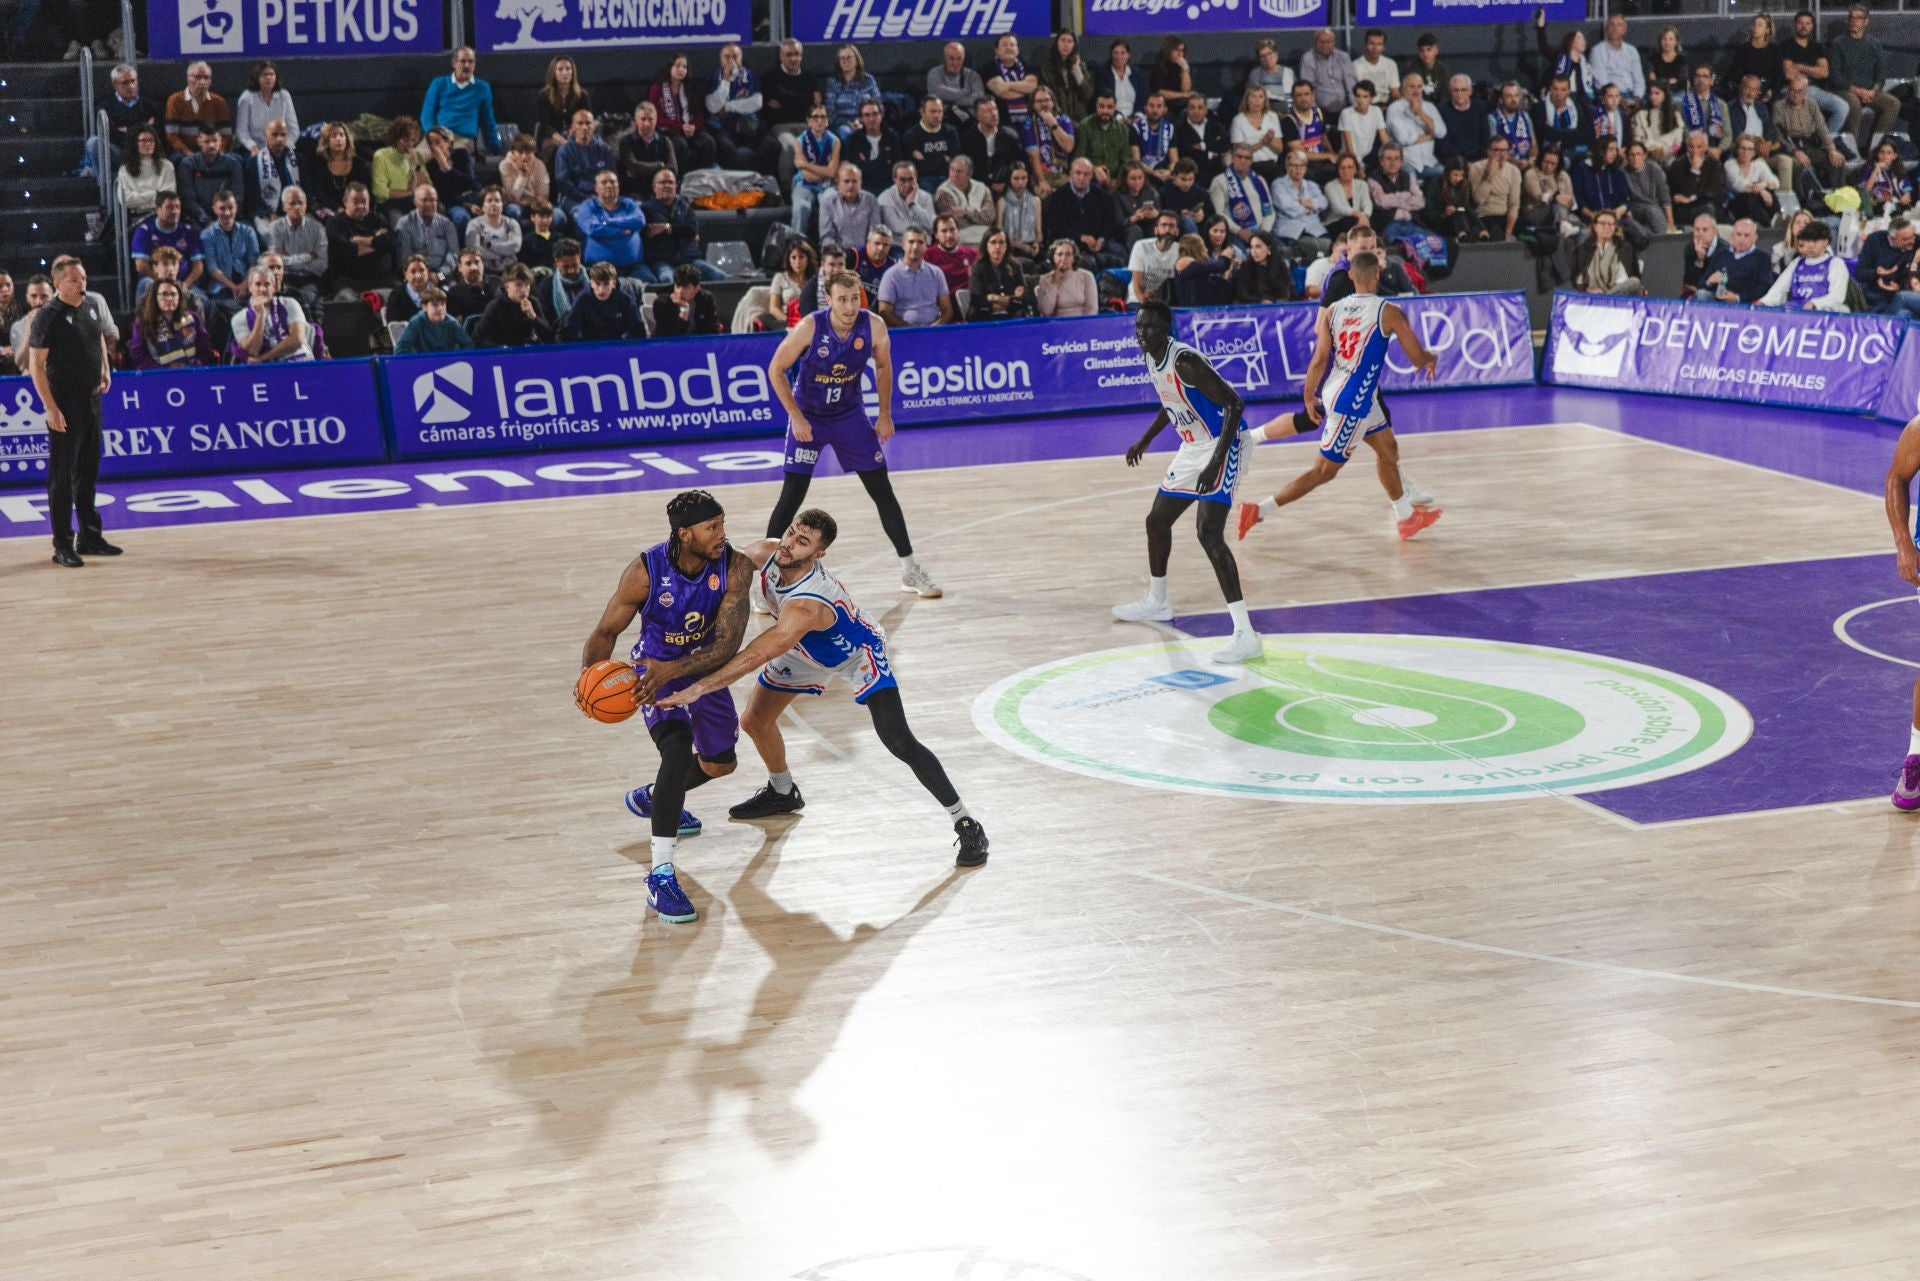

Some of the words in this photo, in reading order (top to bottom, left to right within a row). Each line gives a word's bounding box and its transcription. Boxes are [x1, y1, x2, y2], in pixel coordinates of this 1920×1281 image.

[259, 0, 419, 45] PETKUS
[579, 0, 727, 29] TECNICAMPO
[1042, 341, 1088, 355] Servicios
[1090, 336, 1139, 352] Energétic
[1202, 336, 1257, 355] LuRoPal
[1640, 316, 1886, 365] DENTOMEDIC
[1084, 354, 1146, 370] Climatizació
[493, 352, 771, 419] lambda
[898, 355, 1031, 398] épsilon
[1098, 373, 1151, 388] Calefacció
[1679, 363, 1746, 384] CLÍNICAS
[1749, 369, 1826, 391] DENTALES
[826, 387, 842, 404] 13
[903, 397, 946, 409] SOLUCIONES
[947, 394, 981, 406] TÉRMICAS
[982, 394, 988, 403] Y
[988, 391, 1034, 402] ENERGÉTICAS
[102, 426, 175, 458] REY
[190, 416, 346, 452] SANCHO
[419, 425, 496, 443] cámaras
[501, 417, 600, 441] frigoríficas
[617, 407, 773, 431] www.proylam.es
[16, 442, 49, 455] SANC
[1584, 680, 1675, 713] pasión
[1630, 715, 1688, 745] sobre
[1602, 746, 1643, 759] el
[1339, 776, 1425, 785] con
